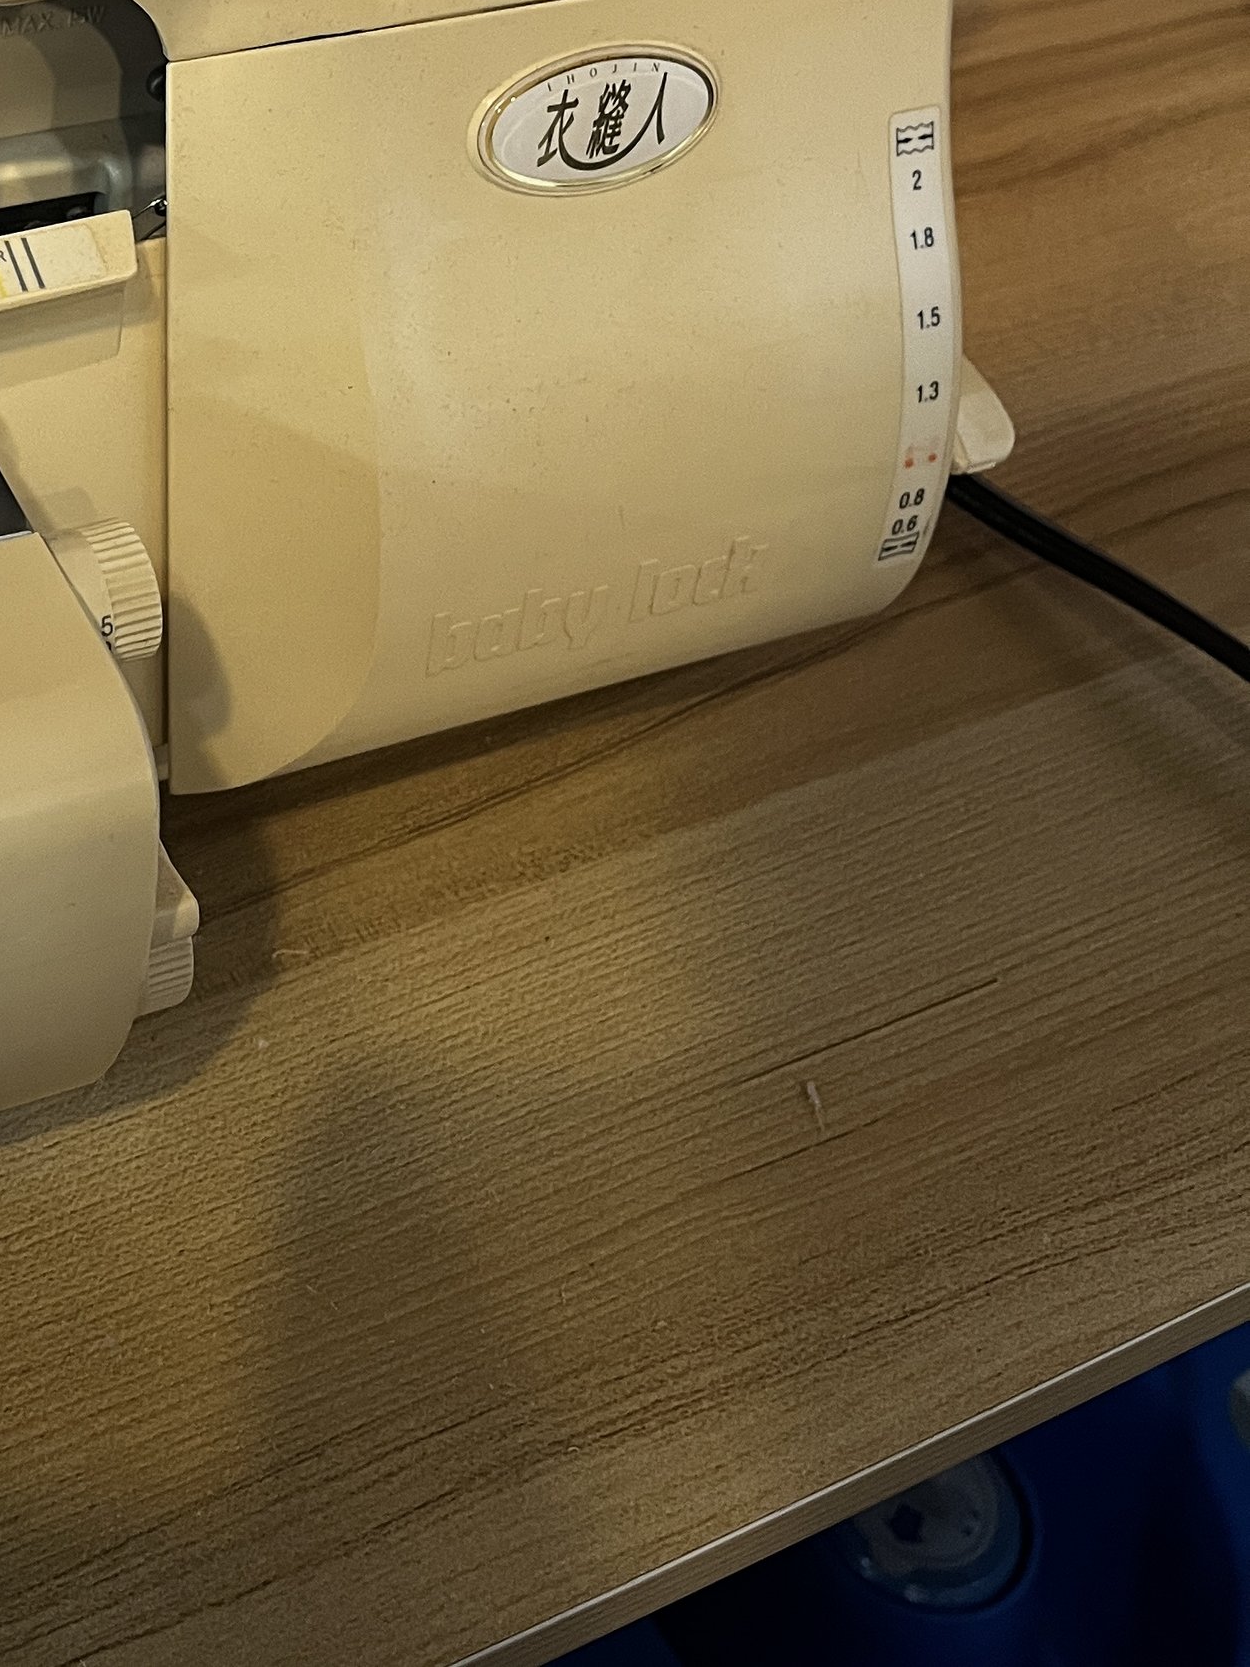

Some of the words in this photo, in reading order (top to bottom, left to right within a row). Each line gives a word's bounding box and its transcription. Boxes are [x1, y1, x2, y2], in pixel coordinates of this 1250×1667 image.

[536, 72, 668, 171] 衣縫人
[911, 169, 922, 191] 2
[910, 226, 935, 250] 1.8
[916, 306, 941, 330] 1.5
[916, 380, 939, 403] 1.3
[898, 488, 925, 510] 0.8
[891, 514, 919, 536] 0.6
[424, 585, 609, 680] baby
[627, 535, 770, 624] lock
[100, 615, 114, 638] 5
